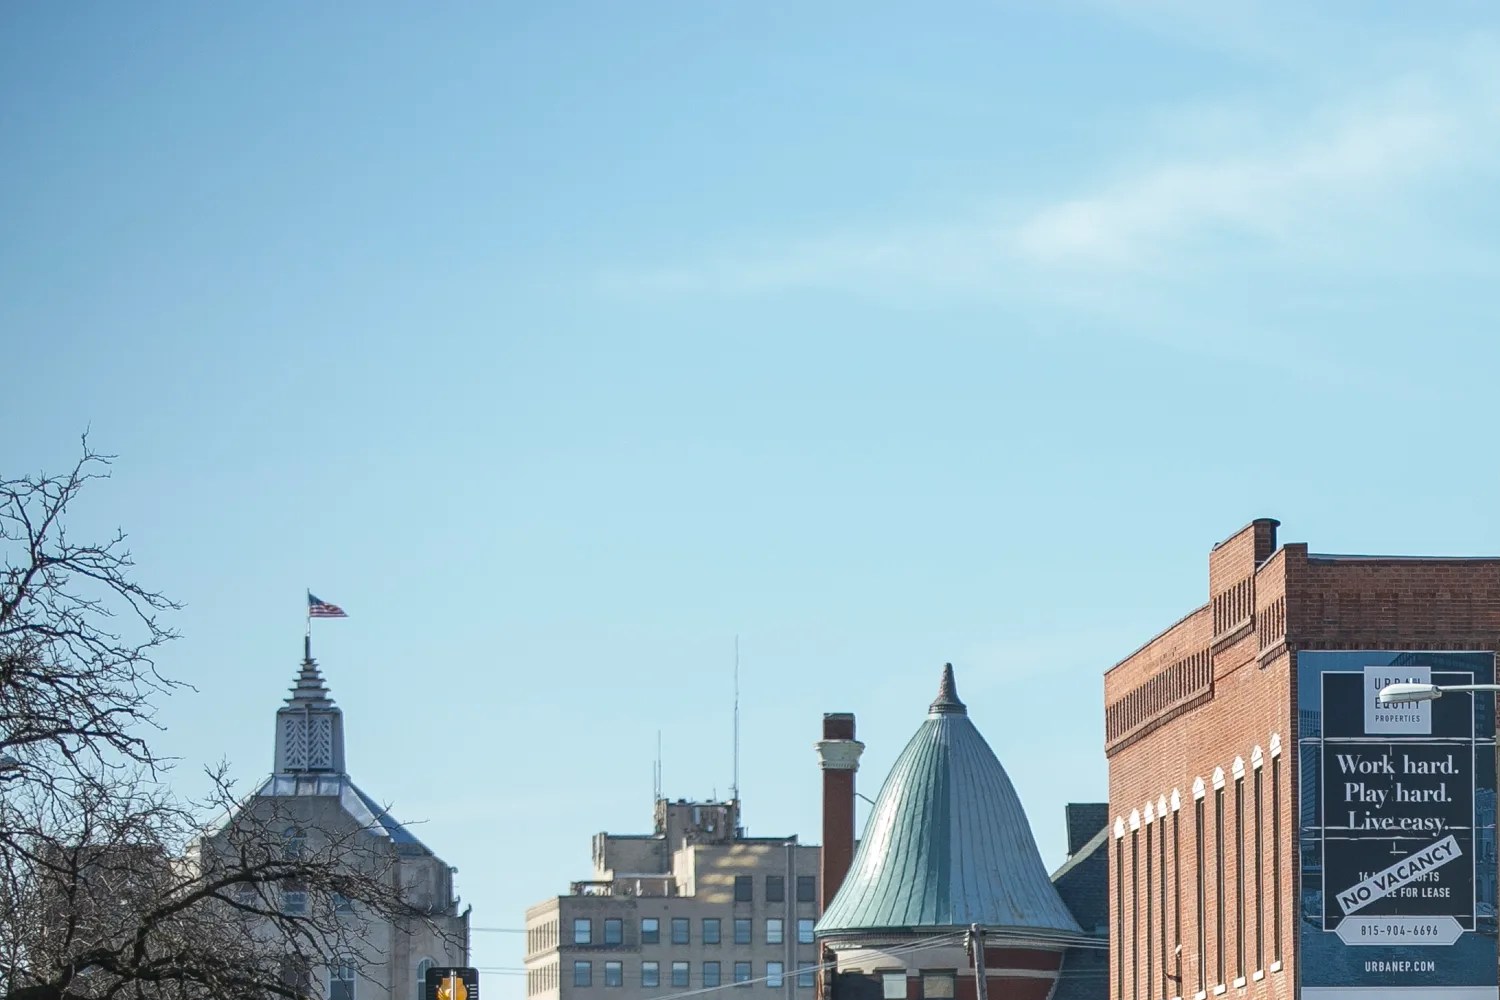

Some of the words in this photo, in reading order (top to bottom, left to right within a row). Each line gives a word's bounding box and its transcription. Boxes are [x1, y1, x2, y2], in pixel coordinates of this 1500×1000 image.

[1375, 714, 1421, 722] PROPERTIES
[1336, 754, 1396, 774] Work
[1403, 754, 1460, 774] hard.
[1344, 782, 1389, 809] Play
[1396, 782, 1453, 802] hard.
[1348, 810, 1394, 831] Live
[1399, 817, 1449, 837] easy.
[1342, 887, 1372, 909] NO
[1373, 841, 1453, 891] VACANCY
[1400, 887, 1419, 898] FOR
[1421, 887, 1451, 898] LEASE
[1361, 925, 1439, 936] 815-904-6696
[1364, 961, 1436, 972] URBANEP.COM
